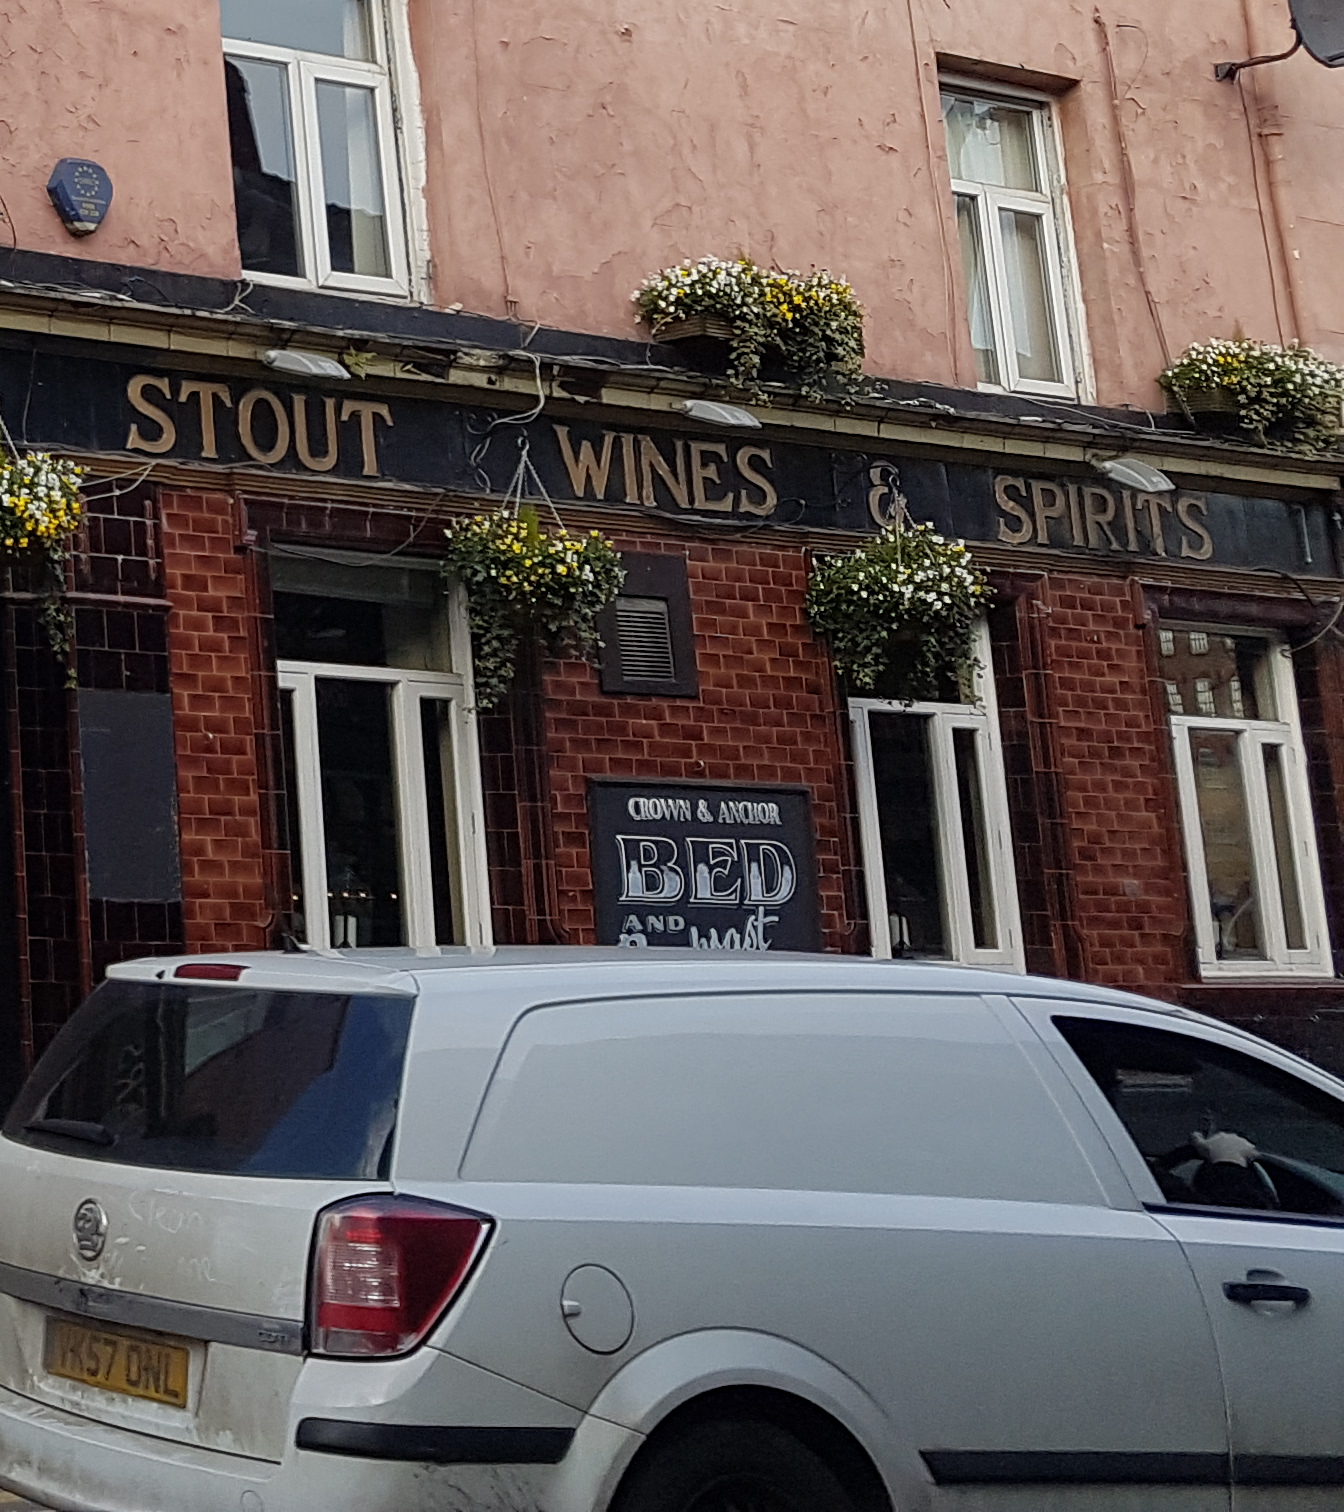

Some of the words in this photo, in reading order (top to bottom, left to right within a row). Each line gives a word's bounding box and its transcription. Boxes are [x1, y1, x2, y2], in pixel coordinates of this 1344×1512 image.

[124, 372, 395, 478] STOUT
[551, 423, 779, 517] WINES
[994, 474, 1216, 561] SPIRITS
[627, 797, 692, 822] CROWN
[696, 797, 714, 823] &
[717, 799, 783, 826] ANCHOR
[615, 834, 797, 907] BED
[622, 914, 686, 933] AND
